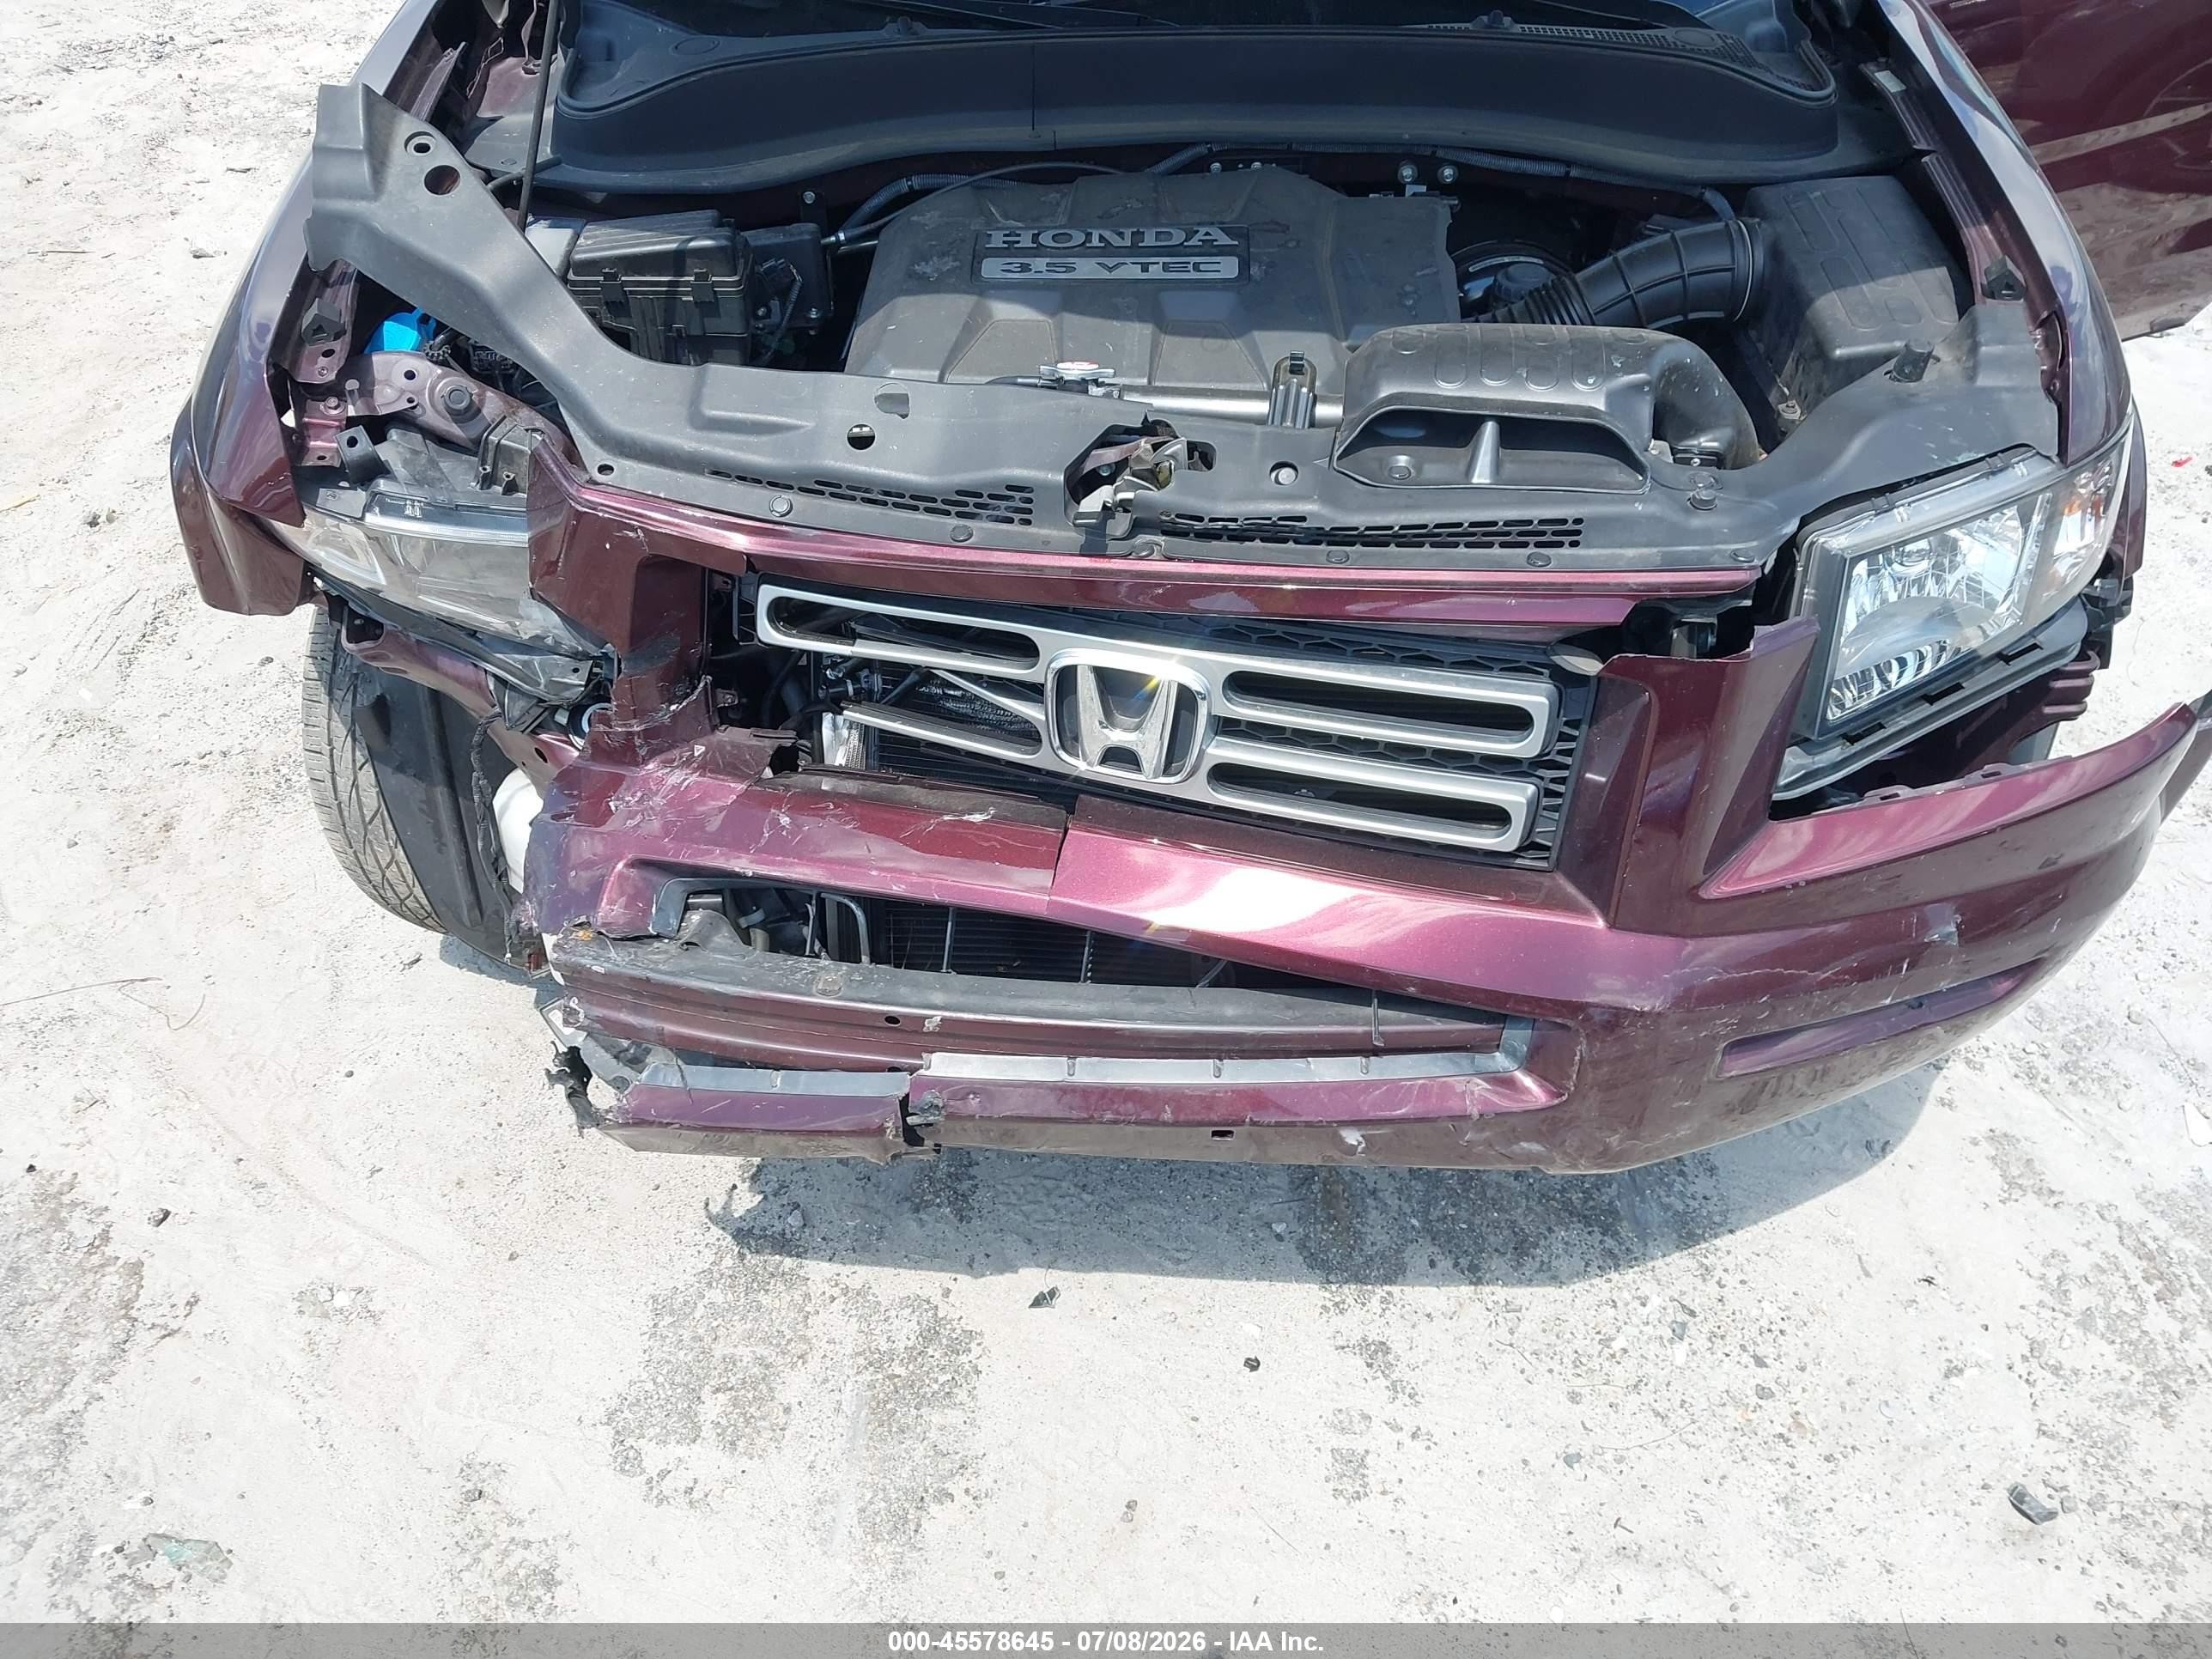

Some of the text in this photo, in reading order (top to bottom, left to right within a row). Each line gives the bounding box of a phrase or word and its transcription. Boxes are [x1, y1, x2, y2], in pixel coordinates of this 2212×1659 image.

[985, 227, 1240, 248] HONDA
[1000, 261, 1222, 274] 3.5 VTEC
